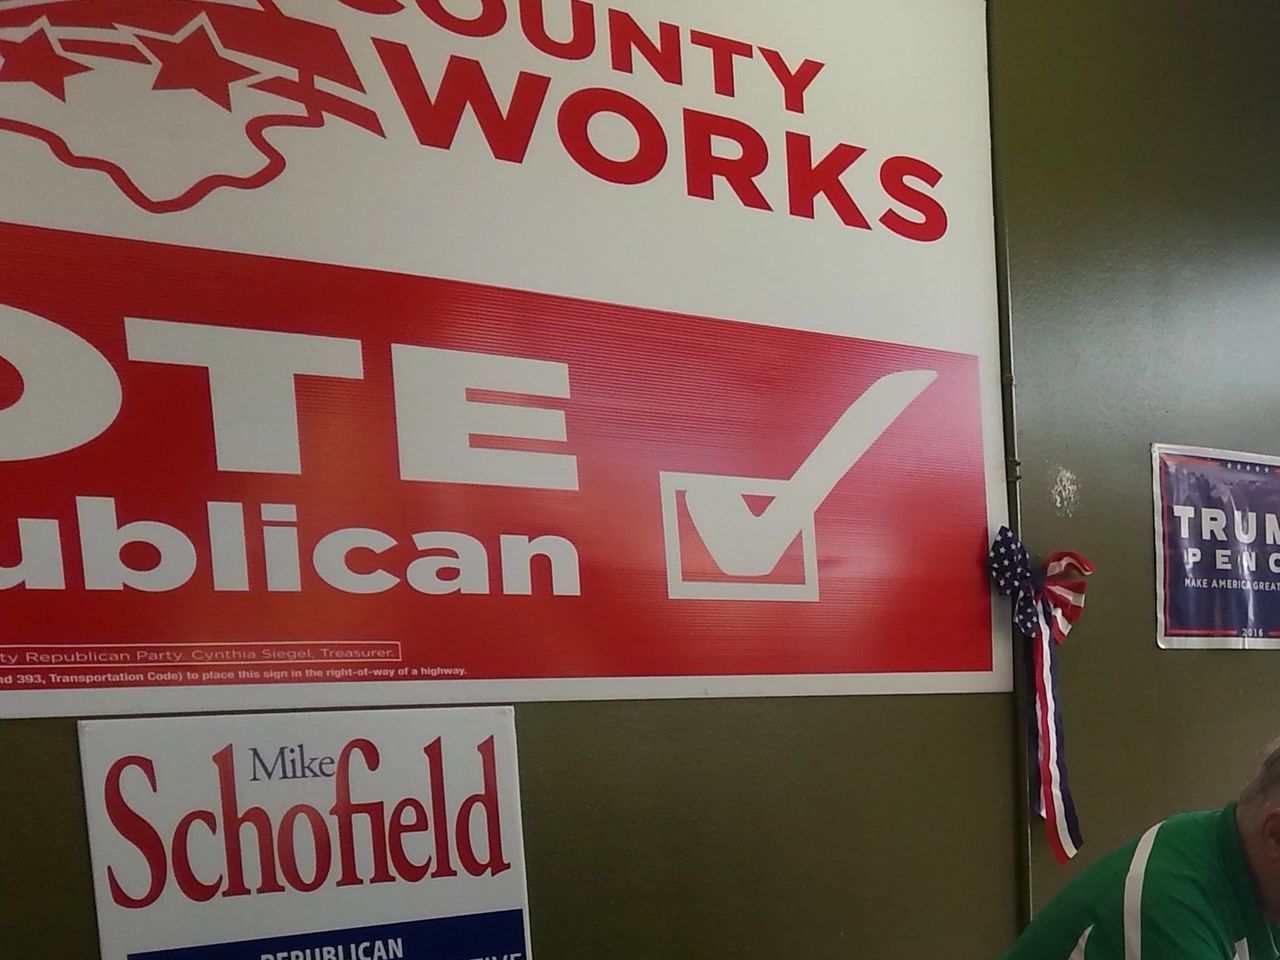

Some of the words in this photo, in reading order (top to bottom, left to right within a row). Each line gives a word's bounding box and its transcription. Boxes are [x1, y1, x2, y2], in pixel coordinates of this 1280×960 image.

[344, 0, 826, 115] OUNTY
[371, 36, 948, 243] WORKS
[1184, 578, 1209, 589] MAKE
[1210, 578, 1251, 590] AMERICA
[1241, 628, 1264, 638] 2016
[26, 651, 130, 664] Republican
[192, 648, 256, 661] Cynthia
[262, 648, 316, 660] Siegel,
[320, 647, 395, 659] Treasurer.
[17, 674, 47, 685] 393,
[50, 672, 144, 683] Transportation
[147, 671, 183, 682] Code)
[187, 671, 199, 680] to
[202, 670, 235, 681] place
[238, 669, 260, 679] this
[263, 669, 289, 680] sign
[291, 668, 302, 677] in
[305, 667, 323, 677] the
[326, 667, 395, 678] right-of-way
[398, 666, 409, 676] of
[420, 666, 467, 676] highway.
[249, 744, 336, 782] Mike
[104, 734, 511, 909] Schofield
